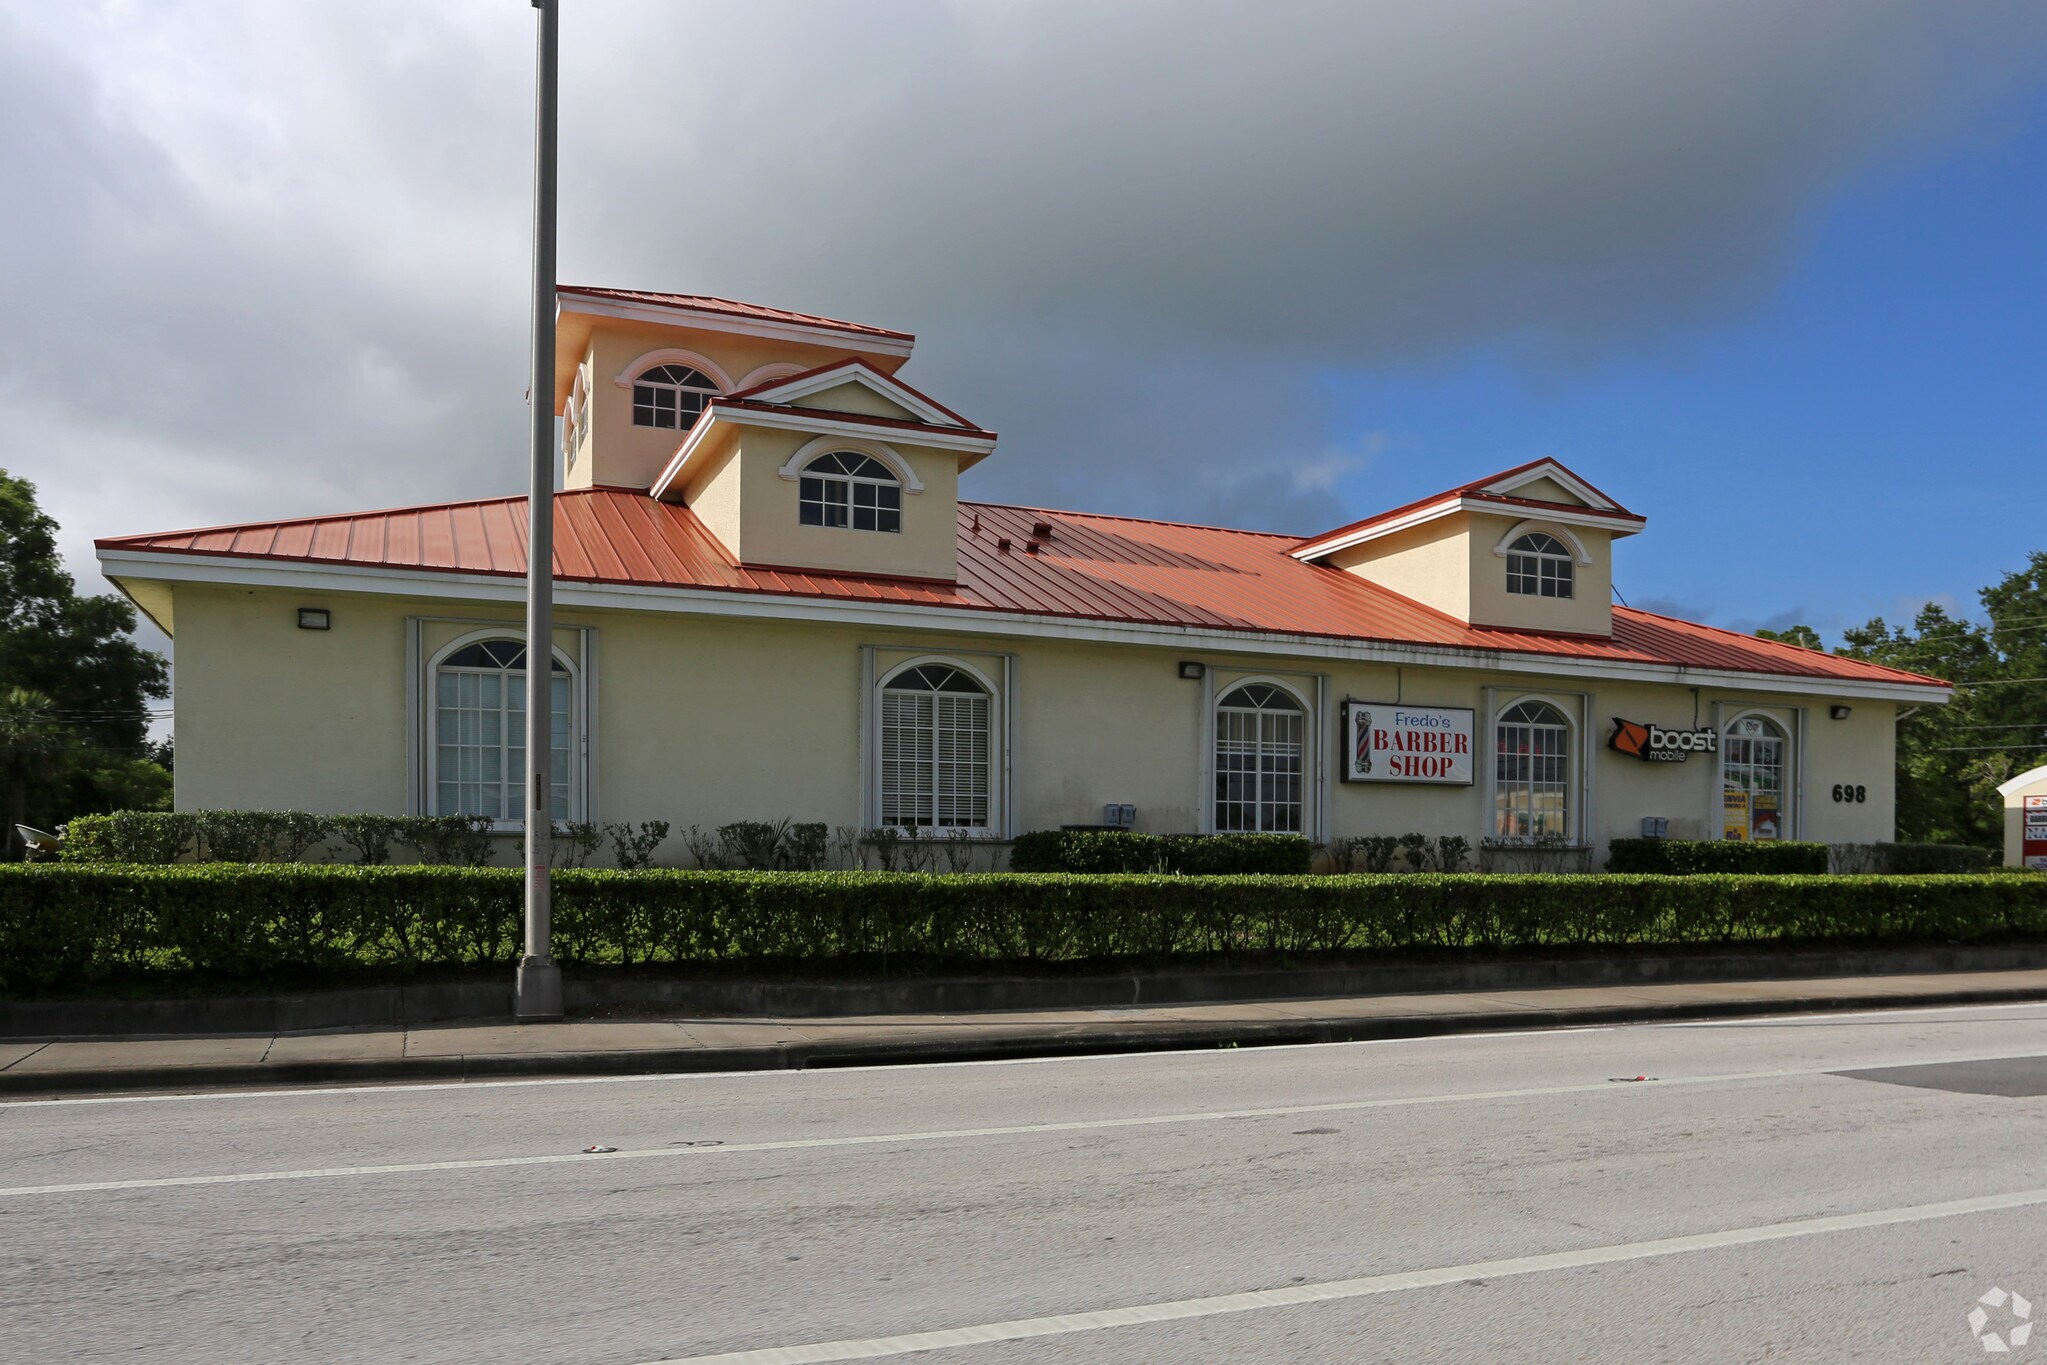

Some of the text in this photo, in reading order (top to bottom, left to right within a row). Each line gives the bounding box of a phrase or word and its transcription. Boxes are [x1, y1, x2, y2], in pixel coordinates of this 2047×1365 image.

[1395, 712, 1451, 728] Fredo's
[1373, 729, 1468, 754] BARBER
[1650, 725, 1716, 751] boost
[1650, 750, 1686, 761] mobile
[1389, 755, 1454, 778] SHOP
[1832, 784, 1866, 803] 698
